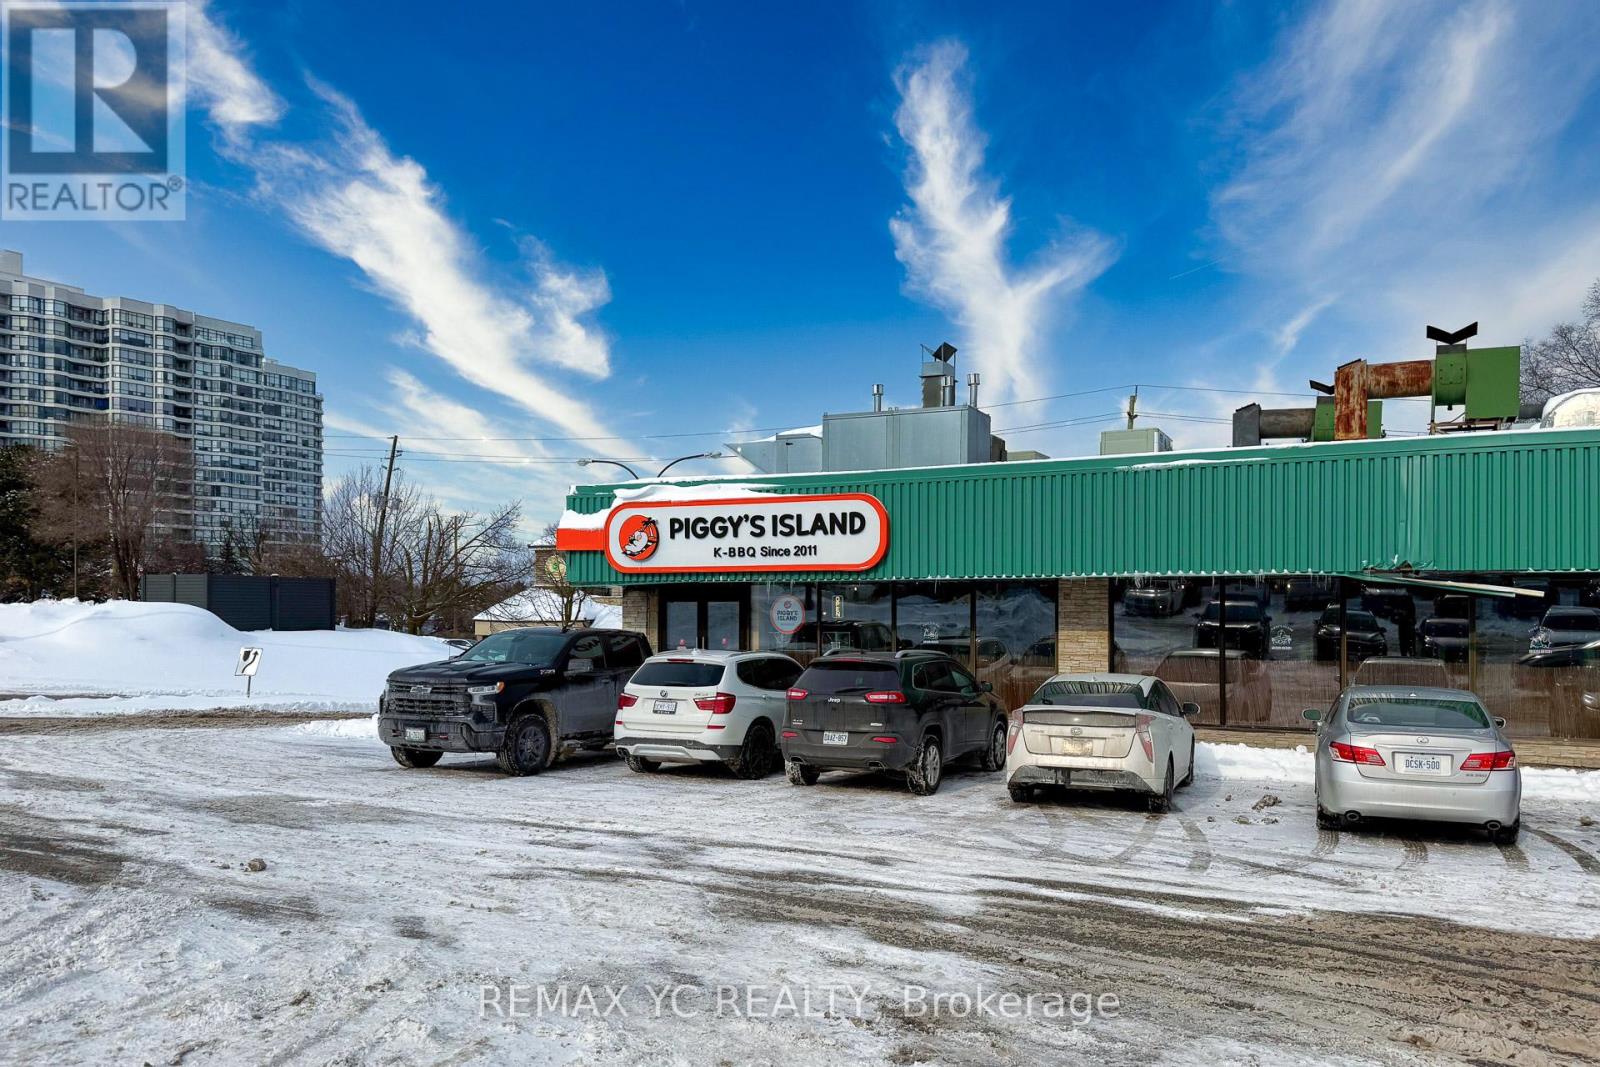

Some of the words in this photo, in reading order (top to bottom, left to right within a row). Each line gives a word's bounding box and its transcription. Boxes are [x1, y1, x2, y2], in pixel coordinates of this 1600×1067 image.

[669, 513, 766, 539] PIGGY'S
[771, 511, 866, 536] ISLAND
[713, 546, 756, 558] K-BBQ
[760, 546, 791, 557] Since
[793, 545, 818, 556] 2011
